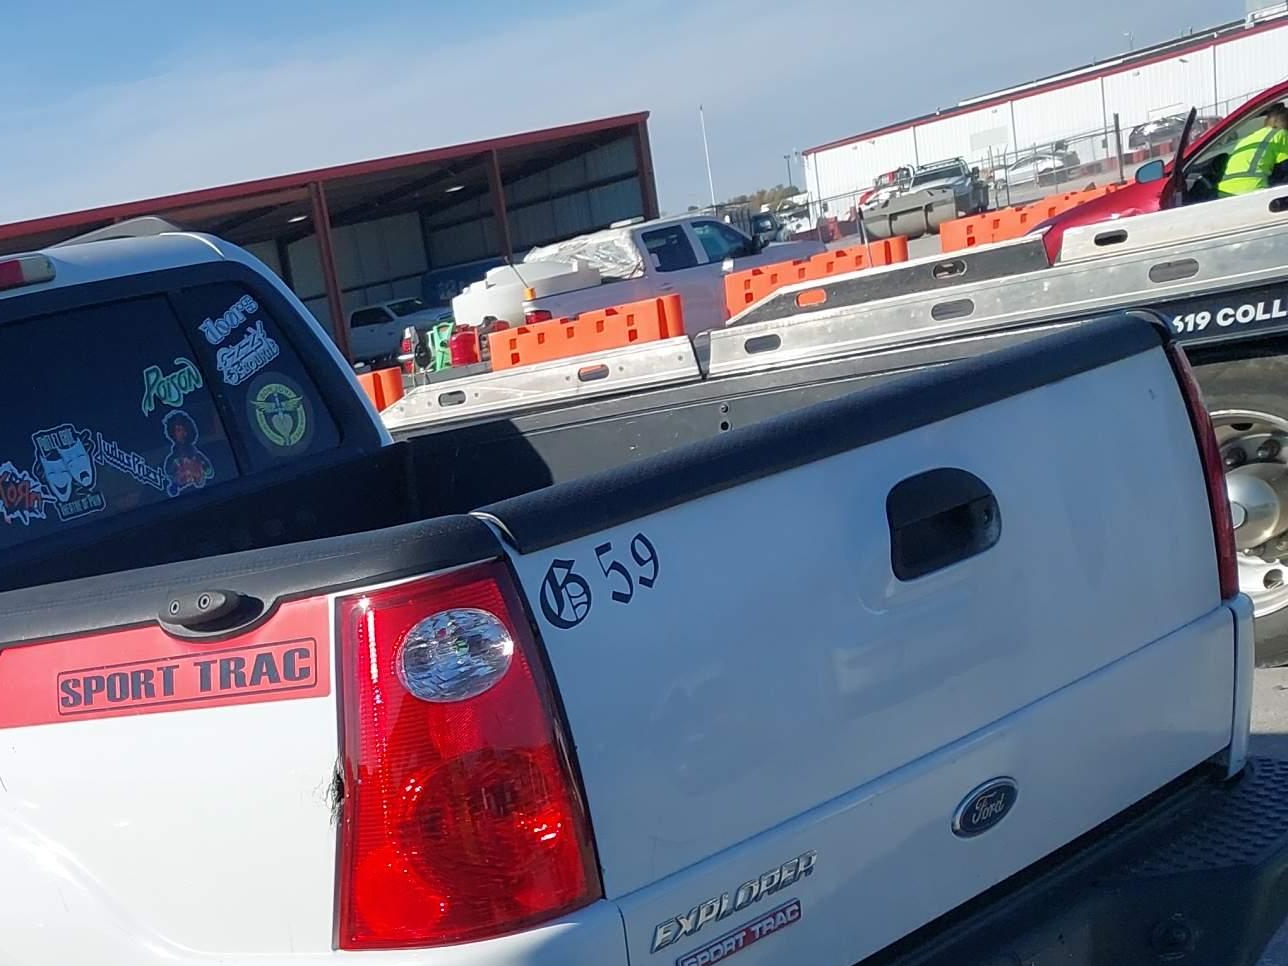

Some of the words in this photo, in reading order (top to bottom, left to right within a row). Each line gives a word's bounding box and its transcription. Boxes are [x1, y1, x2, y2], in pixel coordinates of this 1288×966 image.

[1216, 299, 1288, 327] COLL
[60, 664, 179, 708] SPORT
[194, 647, 311, 692] TRAC
[972, 791, 1005, 825] Ford
[650, 849, 818, 954] EXPLORER
[751, 903, 800, 938] TRAC
